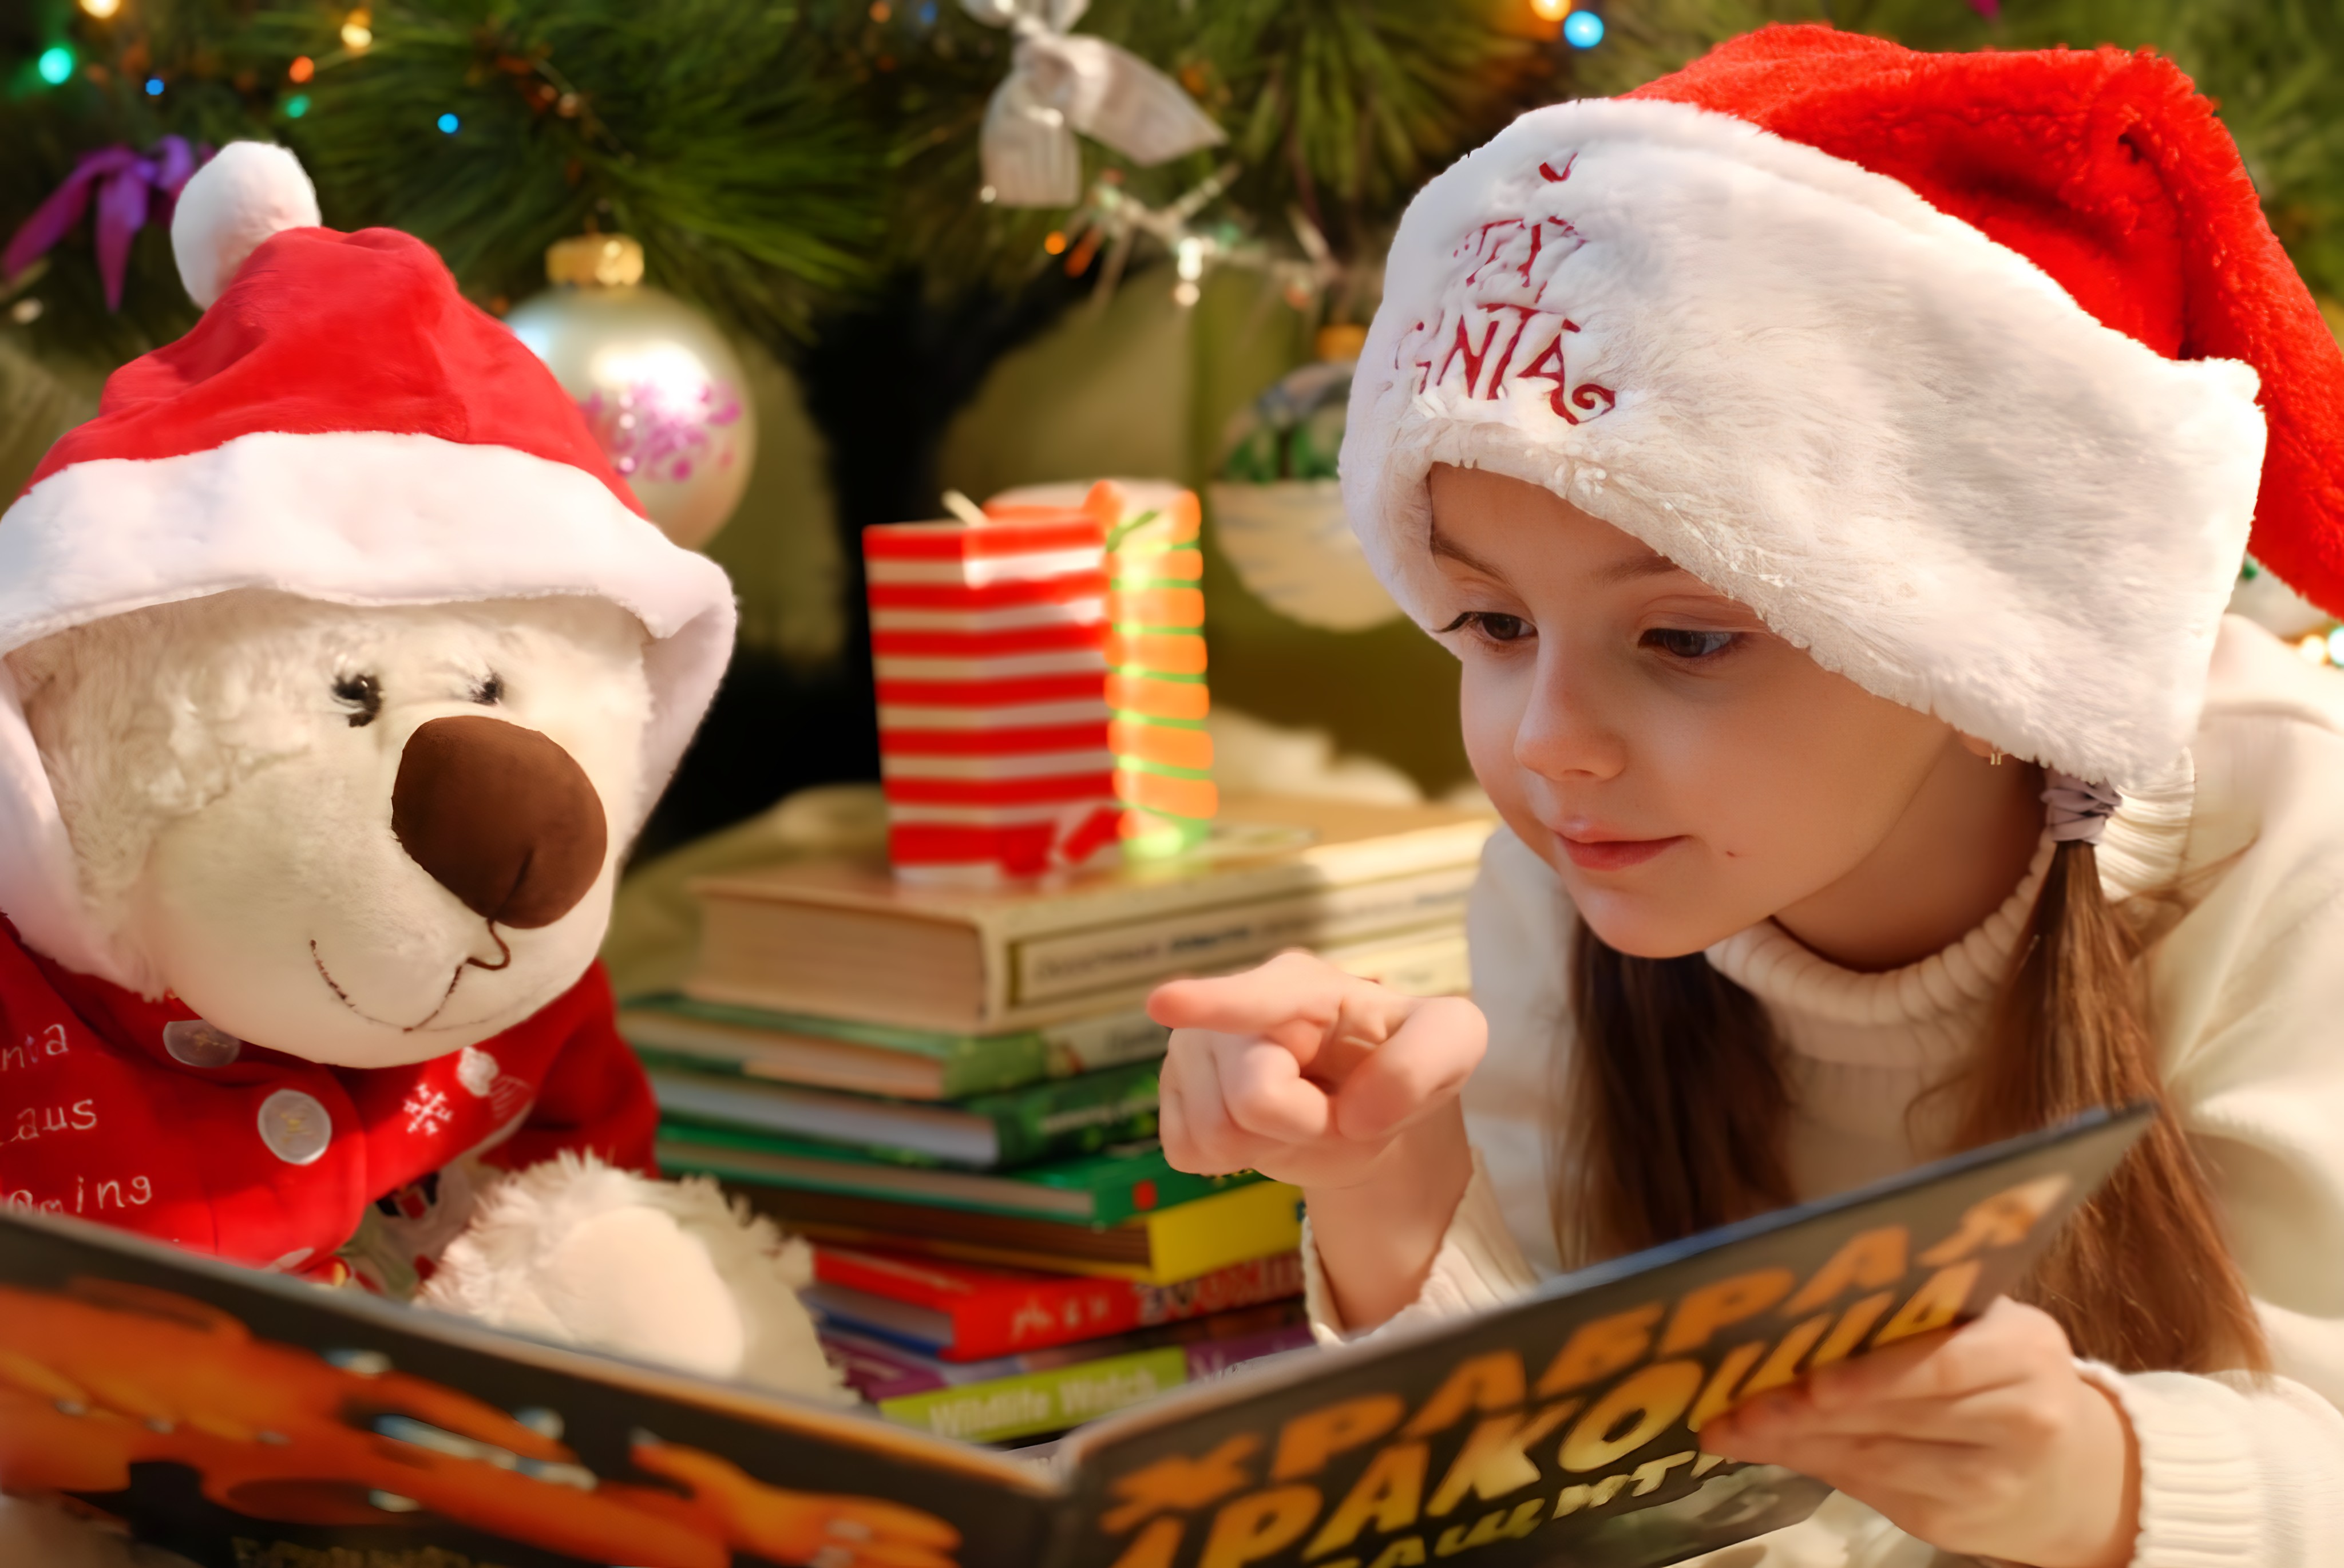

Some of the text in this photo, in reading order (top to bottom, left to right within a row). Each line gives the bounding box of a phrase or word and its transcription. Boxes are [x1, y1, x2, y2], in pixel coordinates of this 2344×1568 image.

[0, 1099, 97, 1145] aus
[928, 1367, 1158, 1438] Wildlife Watch
